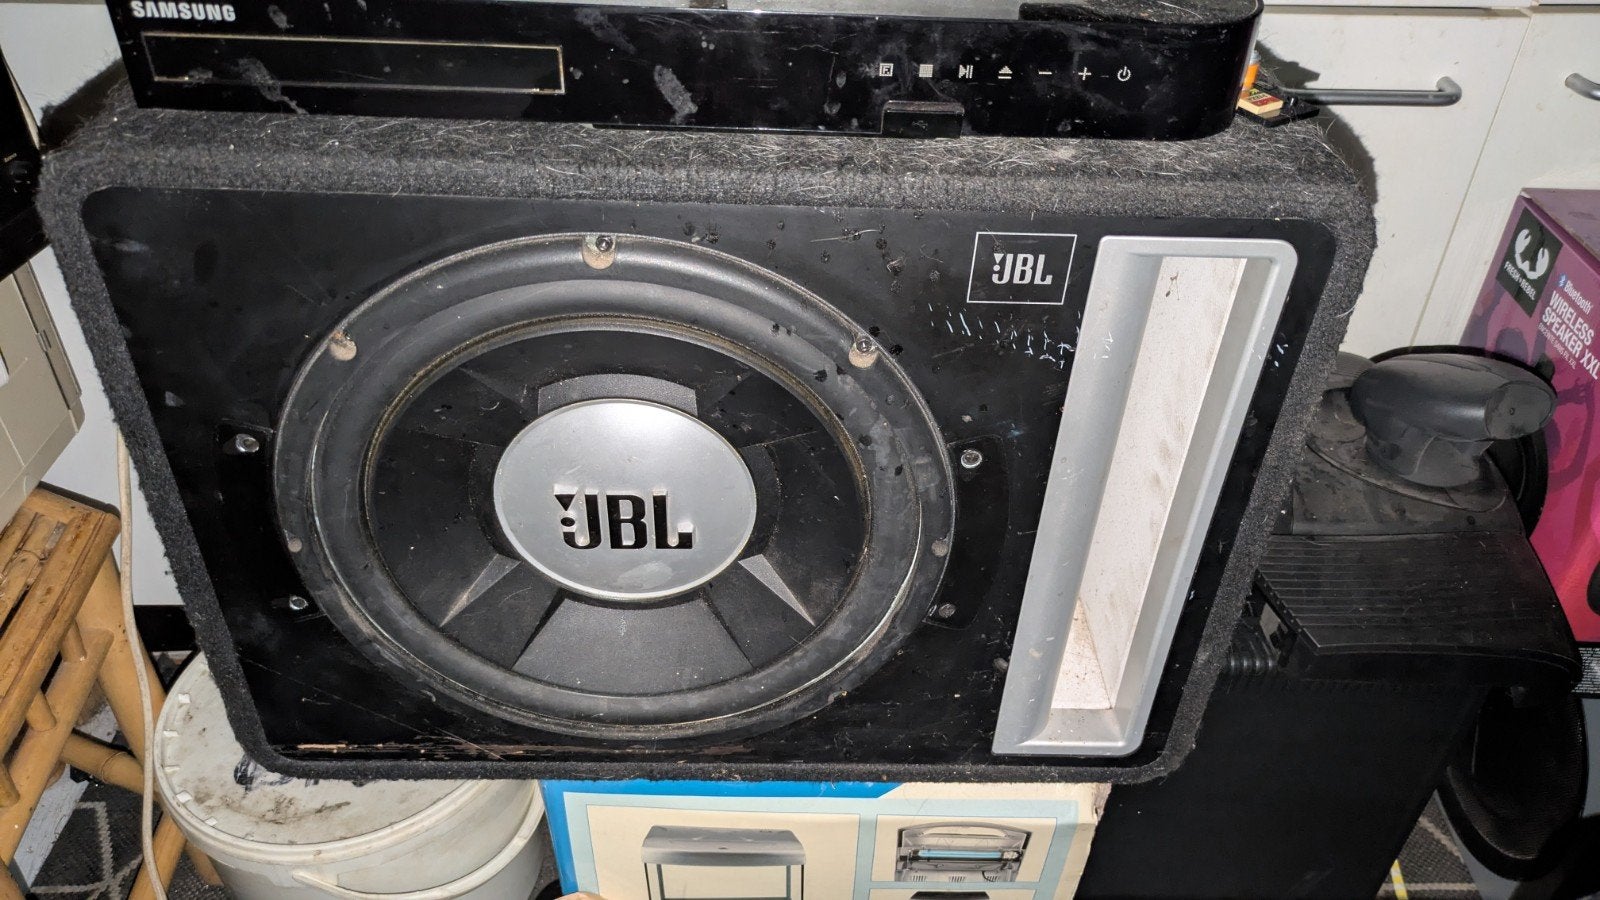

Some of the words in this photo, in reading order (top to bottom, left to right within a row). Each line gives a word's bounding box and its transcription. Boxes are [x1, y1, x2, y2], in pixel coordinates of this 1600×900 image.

[130, 1, 236, 22] SAMSUNG
[992, 253, 1053, 285] JBL
[1504, 261, 1520, 282] FRESH
[1520, 279, 1536, 300] REBEL
[1564, 280, 1591, 315] Bluetooth
[1549, 290, 1595, 346] WIRELESS
[1542, 306, 1583, 358] SPEAKER
[1580, 348, 1600, 380] XXL
[554, 490, 693, 550] JBL
